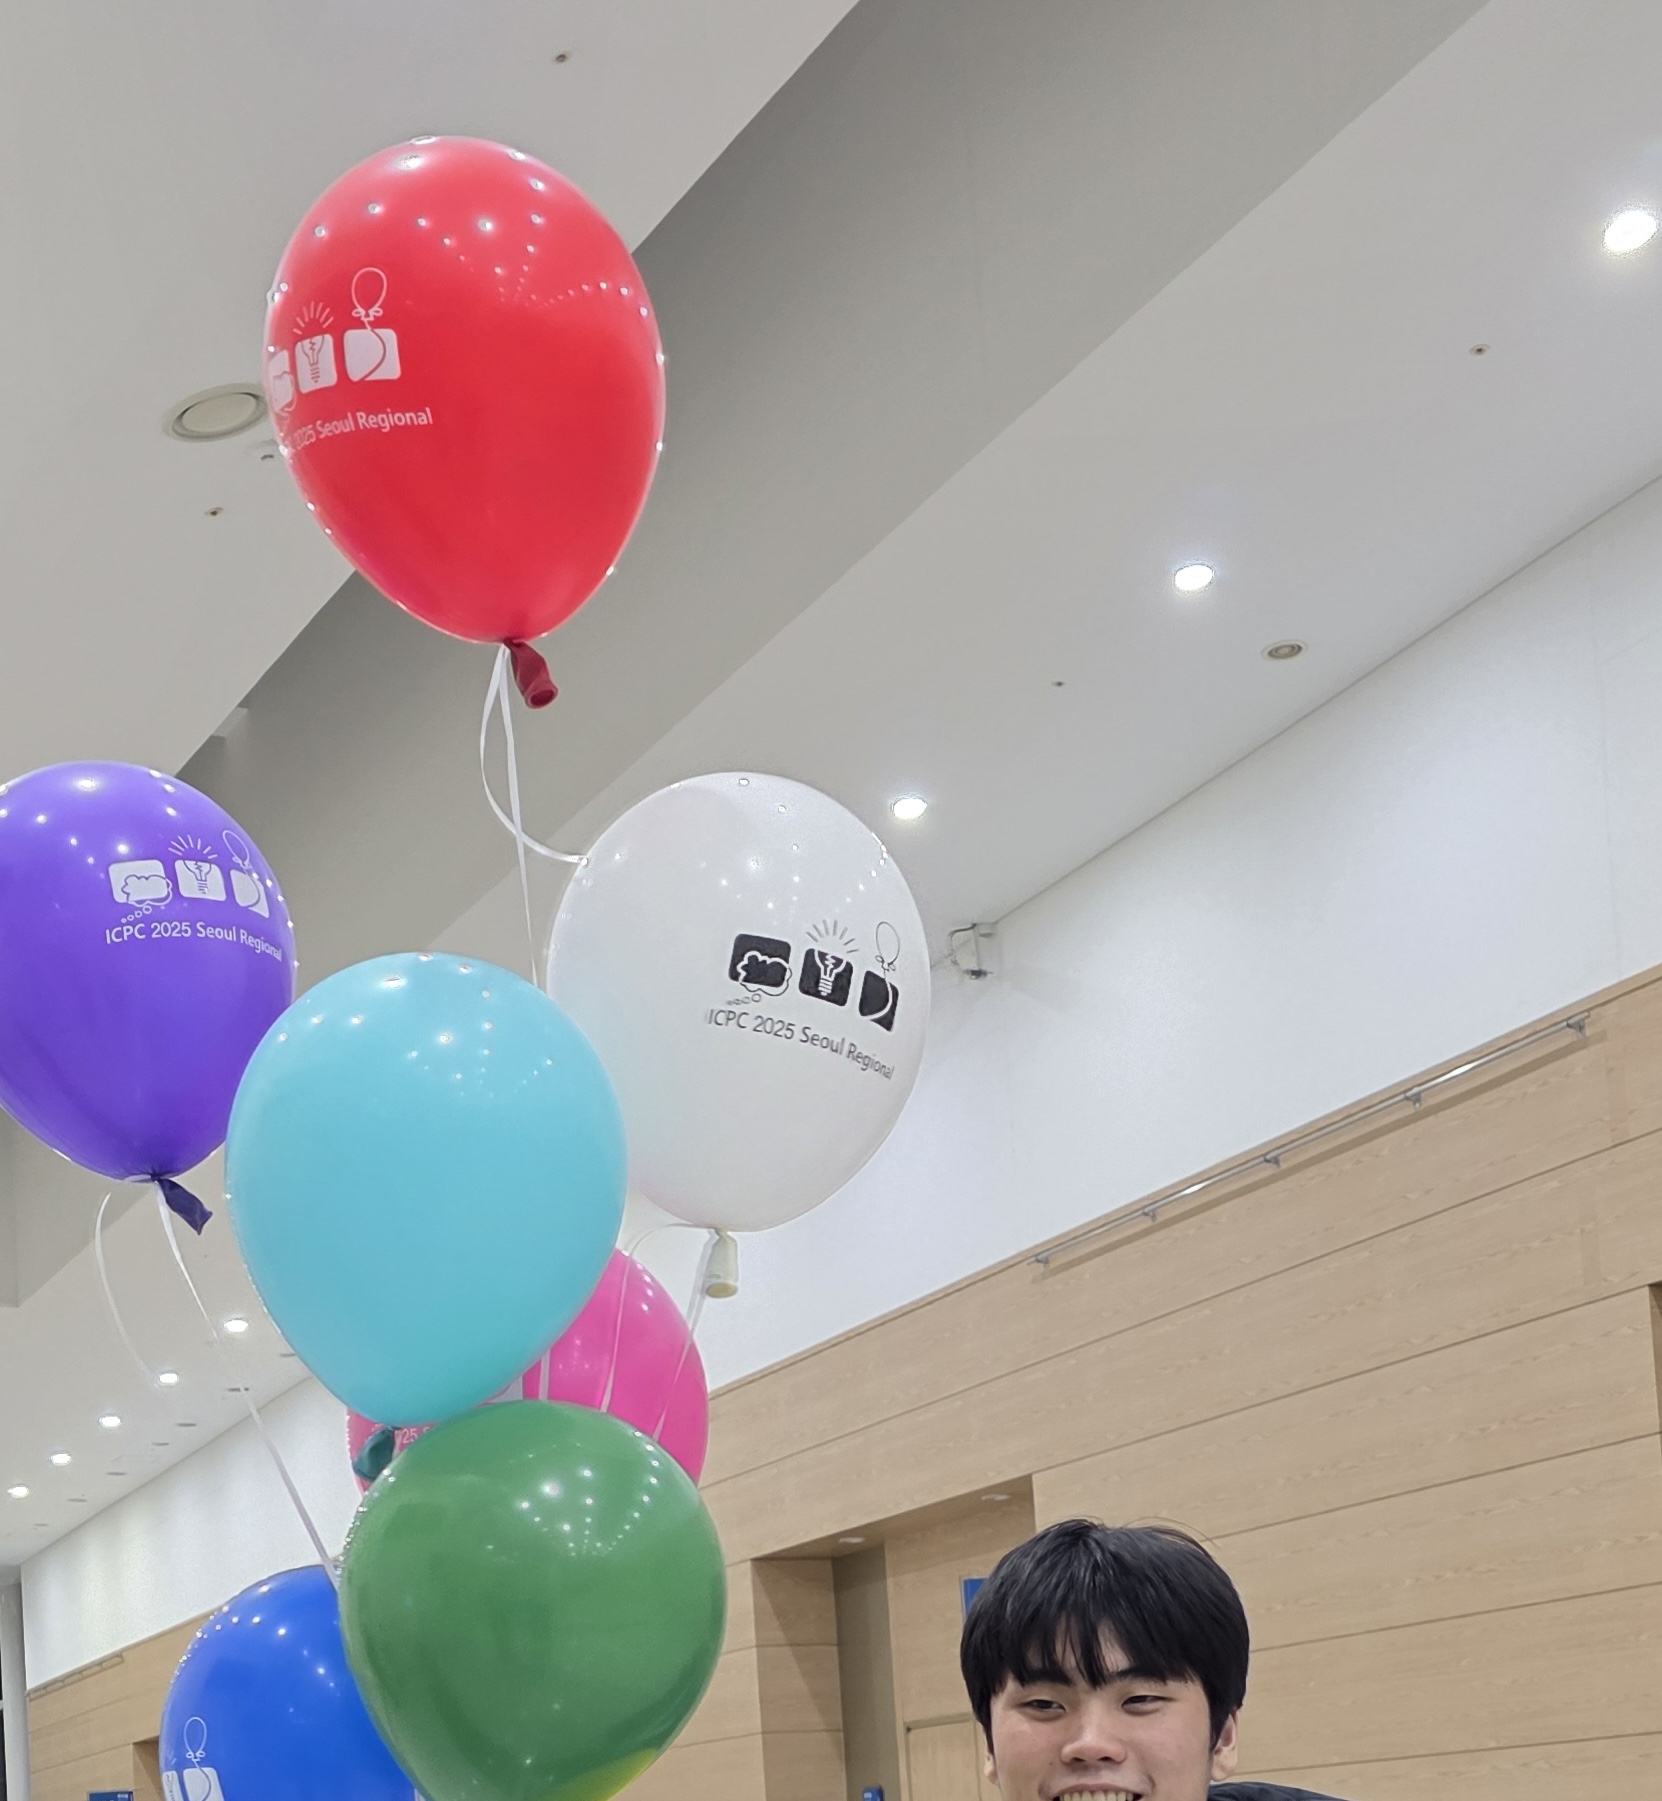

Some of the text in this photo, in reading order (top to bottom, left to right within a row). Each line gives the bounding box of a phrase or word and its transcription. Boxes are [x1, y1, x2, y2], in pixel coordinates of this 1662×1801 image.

[316, 412, 355, 439] Seoul
[356, 407, 433, 433] Regional
[105, 921, 282, 962] ICPC 2025 Seoul Regional
[706, 1009, 895, 1080] ICPC 2025 Seoul Regional
